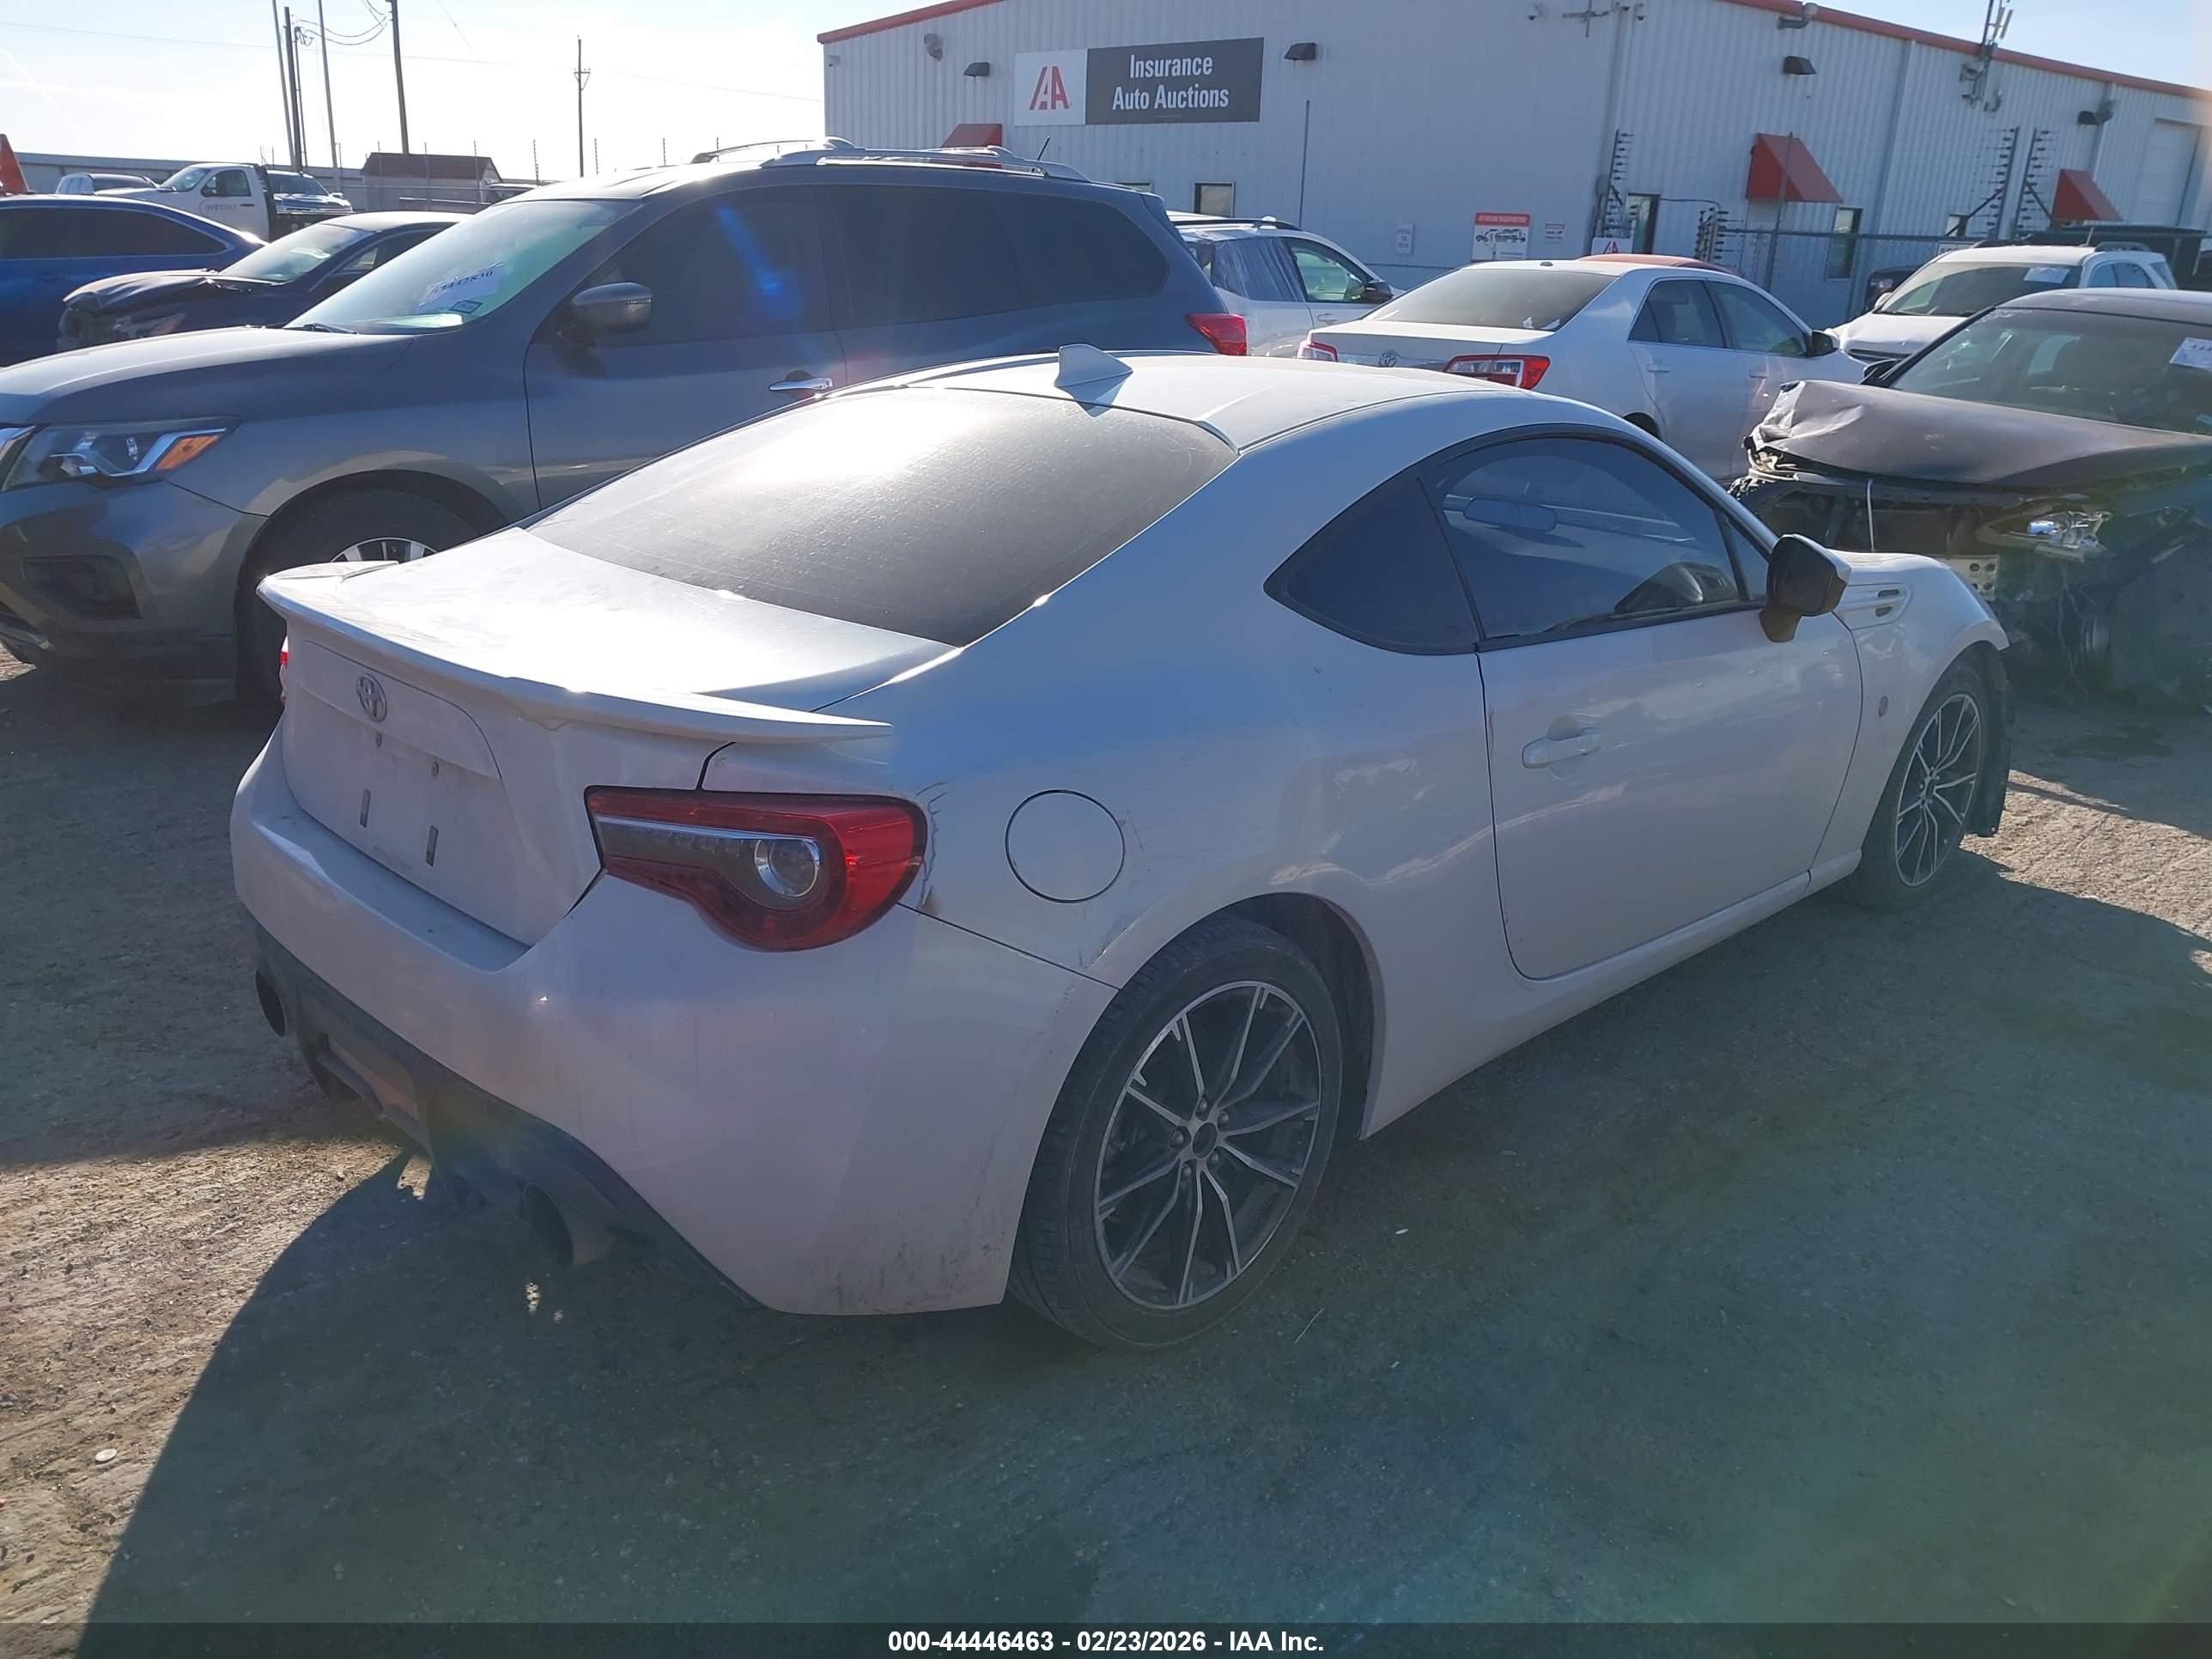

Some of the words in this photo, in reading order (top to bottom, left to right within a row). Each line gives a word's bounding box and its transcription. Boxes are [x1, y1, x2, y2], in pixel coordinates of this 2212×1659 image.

[1129, 54, 1213, 78] Insurance
[1112, 86, 1150, 110] Auto
[1154, 83, 1230, 109] Auctions
